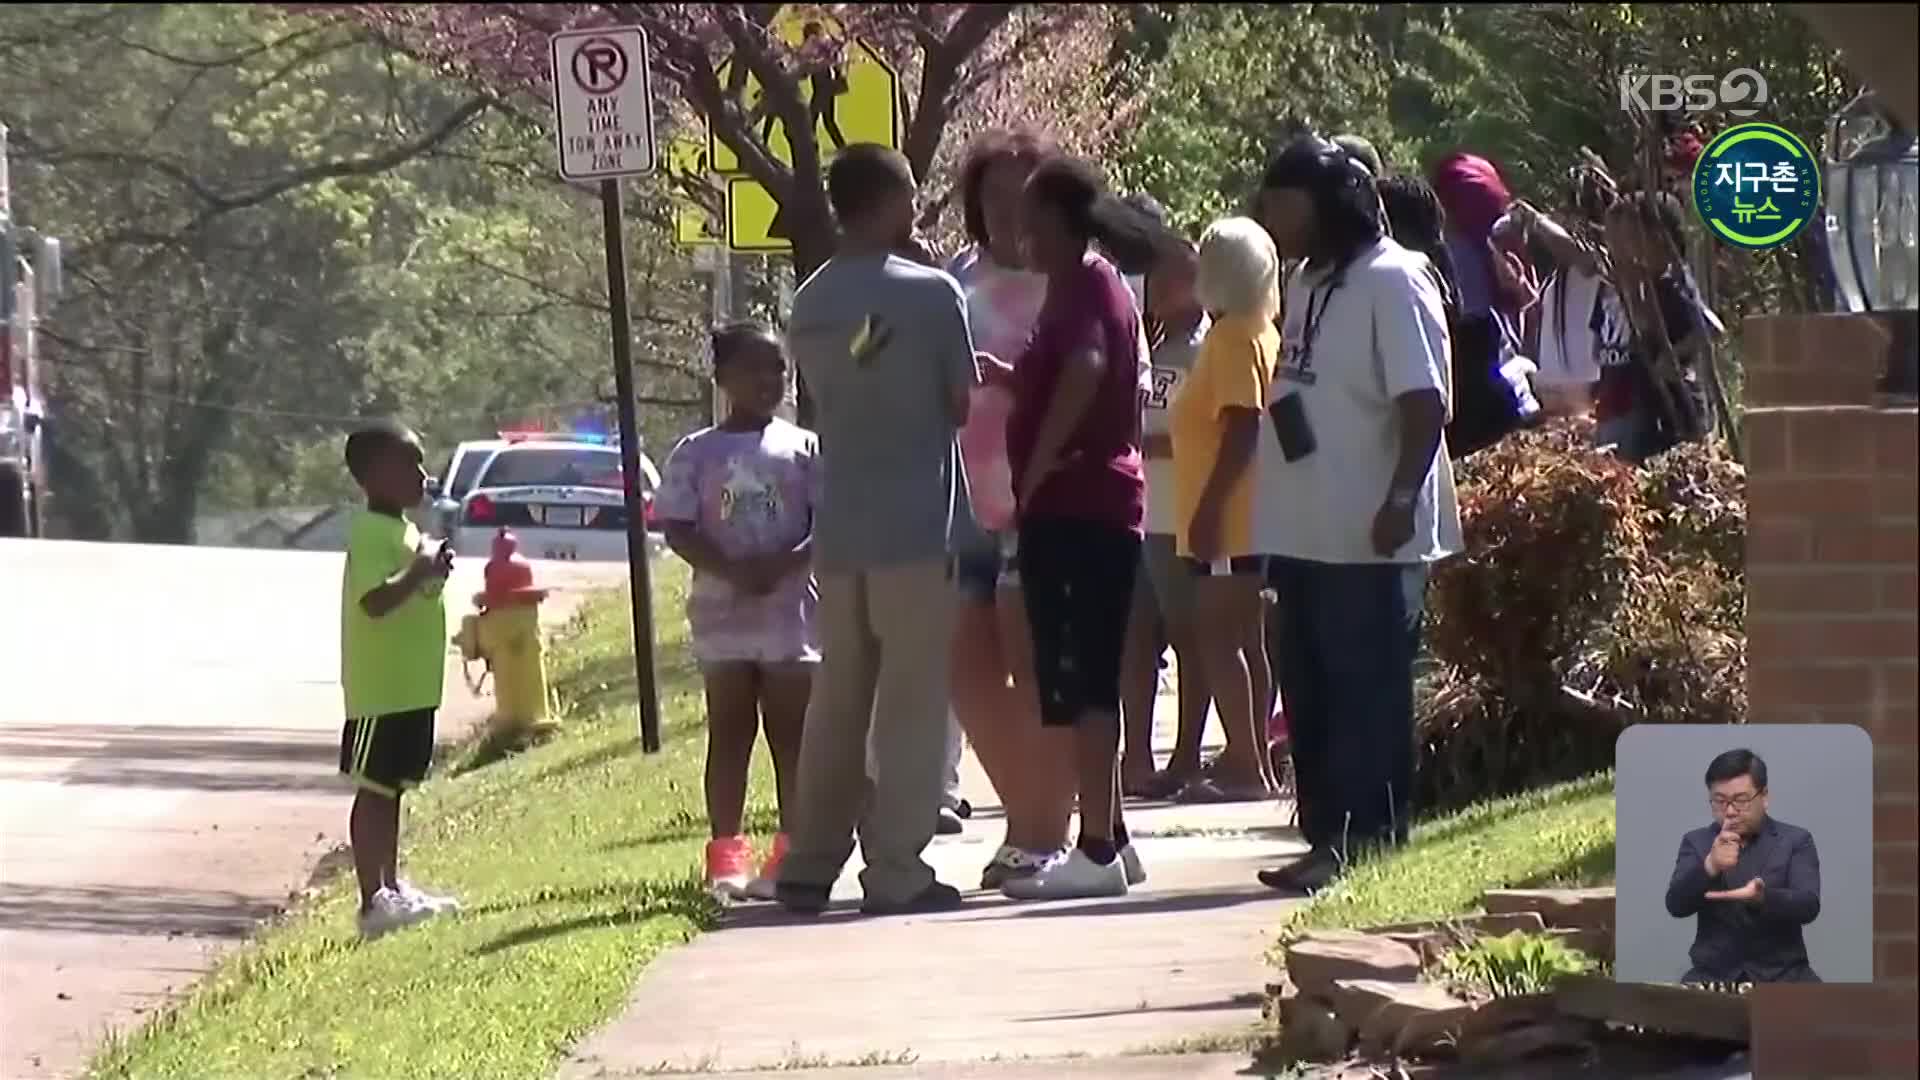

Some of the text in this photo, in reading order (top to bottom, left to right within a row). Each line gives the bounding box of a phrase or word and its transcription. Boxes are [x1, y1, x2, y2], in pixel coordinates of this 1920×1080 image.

[587, 96, 619, 114] ANY
[588, 114, 621, 133] TIME
[569, 132, 643, 153] TOW AWAY
[592, 153, 623, 170] ZONE
